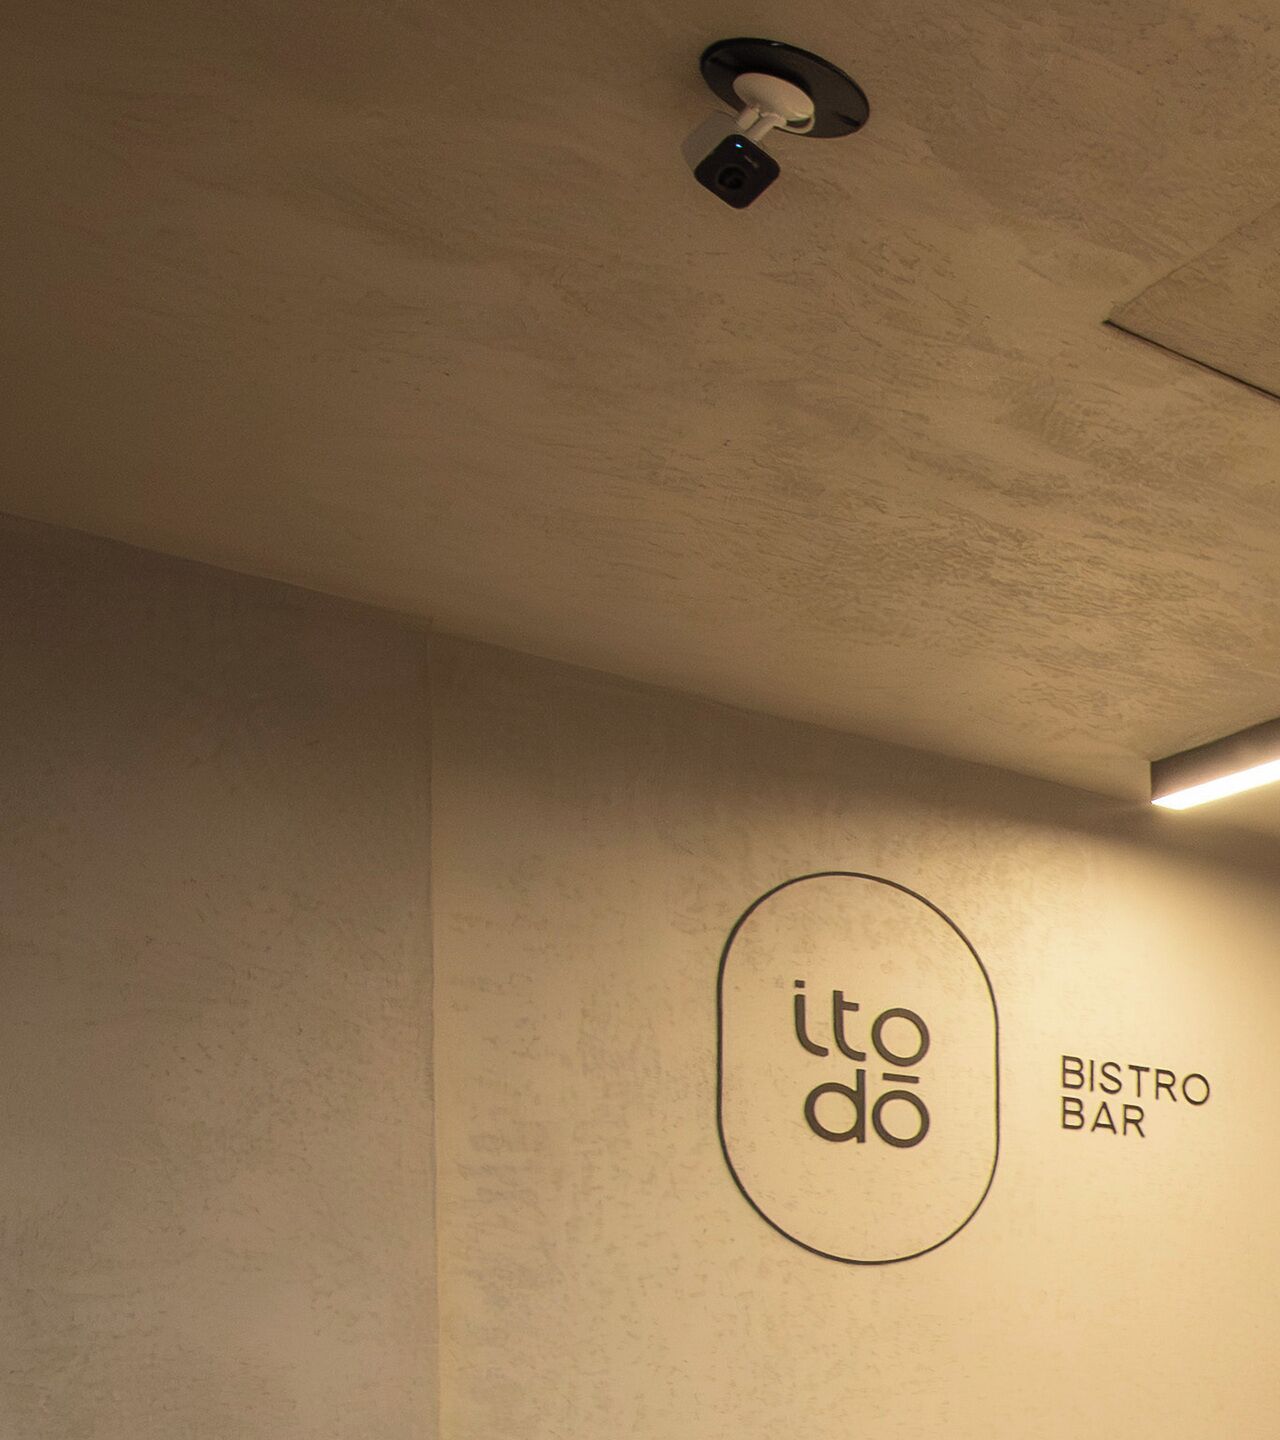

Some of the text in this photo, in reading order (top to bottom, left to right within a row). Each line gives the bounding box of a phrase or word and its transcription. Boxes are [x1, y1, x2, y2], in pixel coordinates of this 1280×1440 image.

[793, 979, 931, 1067] ito
[1061, 1054, 1212, 1107] BISTRO
[1061, 1095, 1147, 1138] BAR
